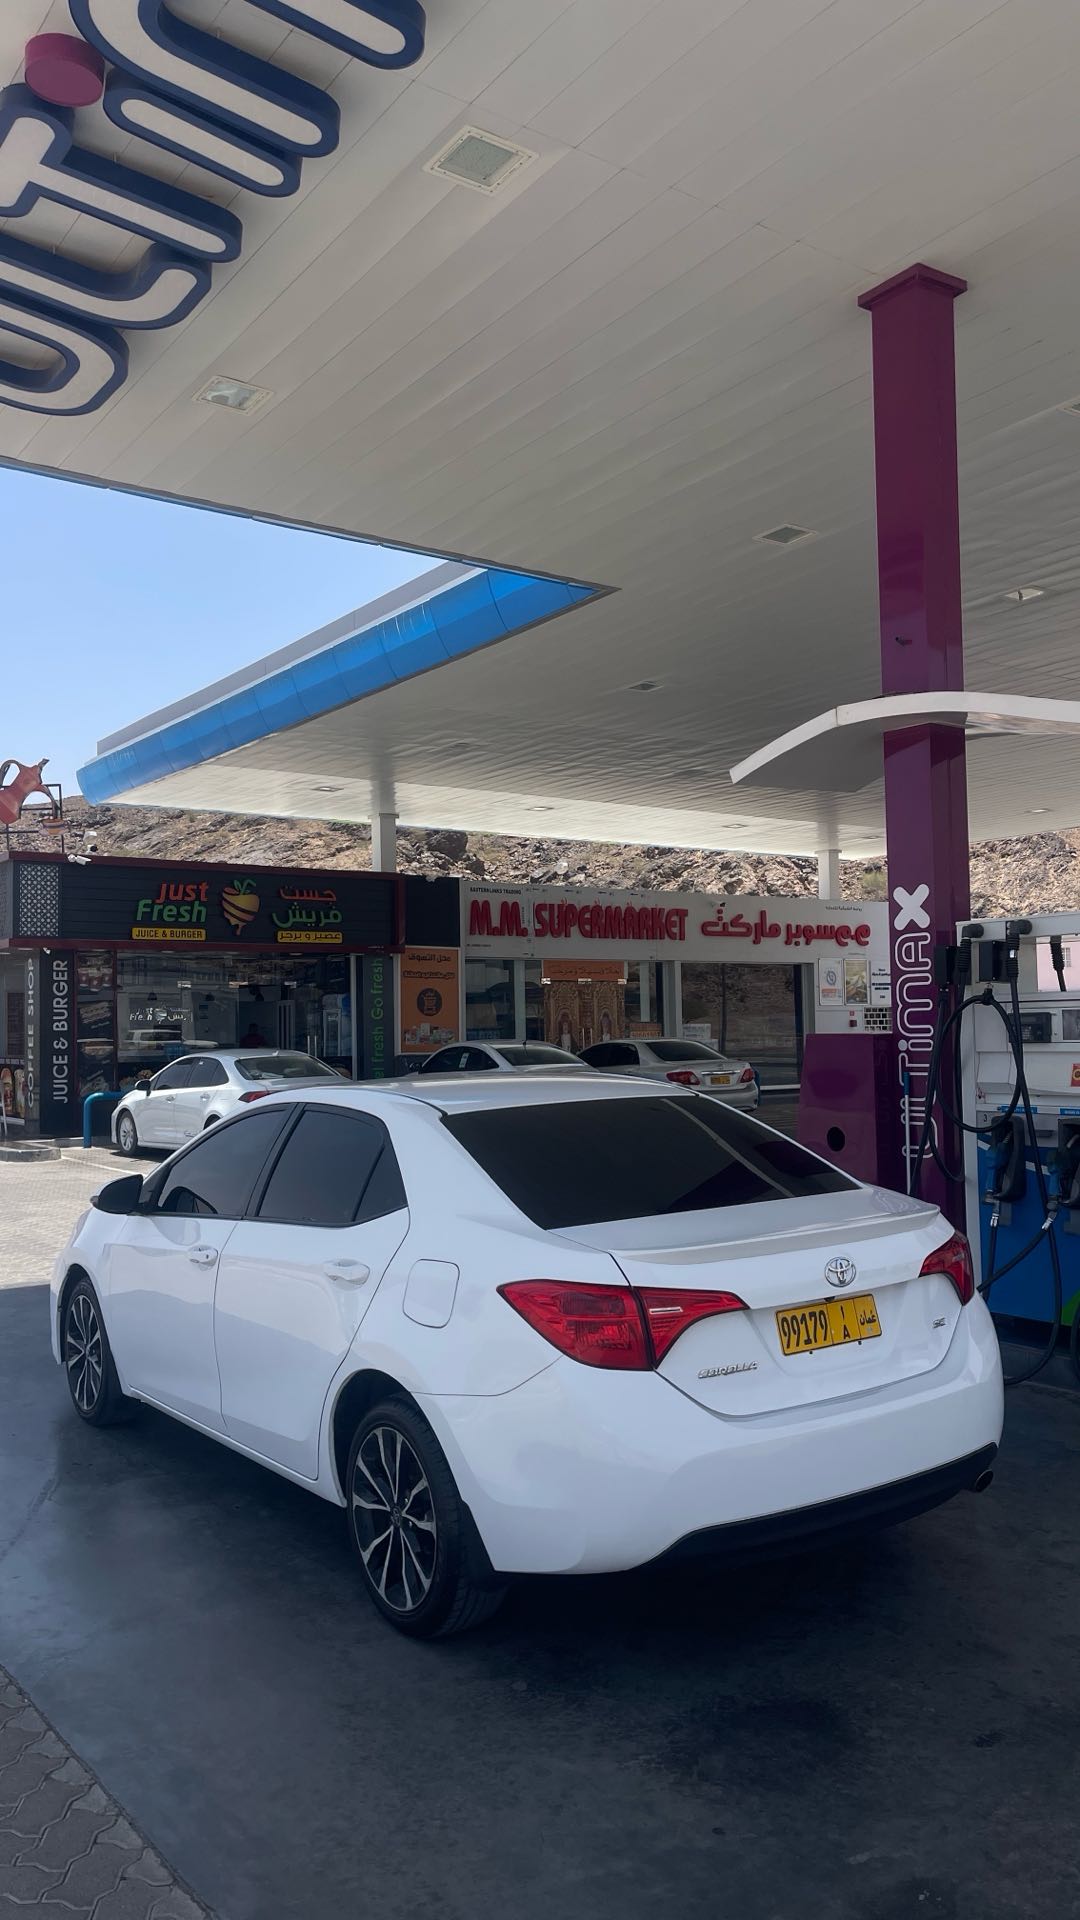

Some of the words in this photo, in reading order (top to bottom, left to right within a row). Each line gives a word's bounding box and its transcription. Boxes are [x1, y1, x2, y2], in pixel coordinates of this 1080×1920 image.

[279, 884, 337, 905] جست
[136, 899, 208, 923] Fresh
[272, 902, 343, 928] فريش
[469, 899, 529, 938] M.M.
[533, 902, 689, 941] SUPERMARKET
[135, 929, 160, 938] JUICE
[161, 929, 168, 938] &
[169, 929, 203, 939] BURGER
[52, 960, 69, 1031] BURGER
[371, 997, 384, 1020] Go
[52, 1037, 69, 1050] &
[52, 1054, 69, 1104] JUICE
[780, 1310, 829, 1349] 99179
[843, 1325, 851, 1340] A
